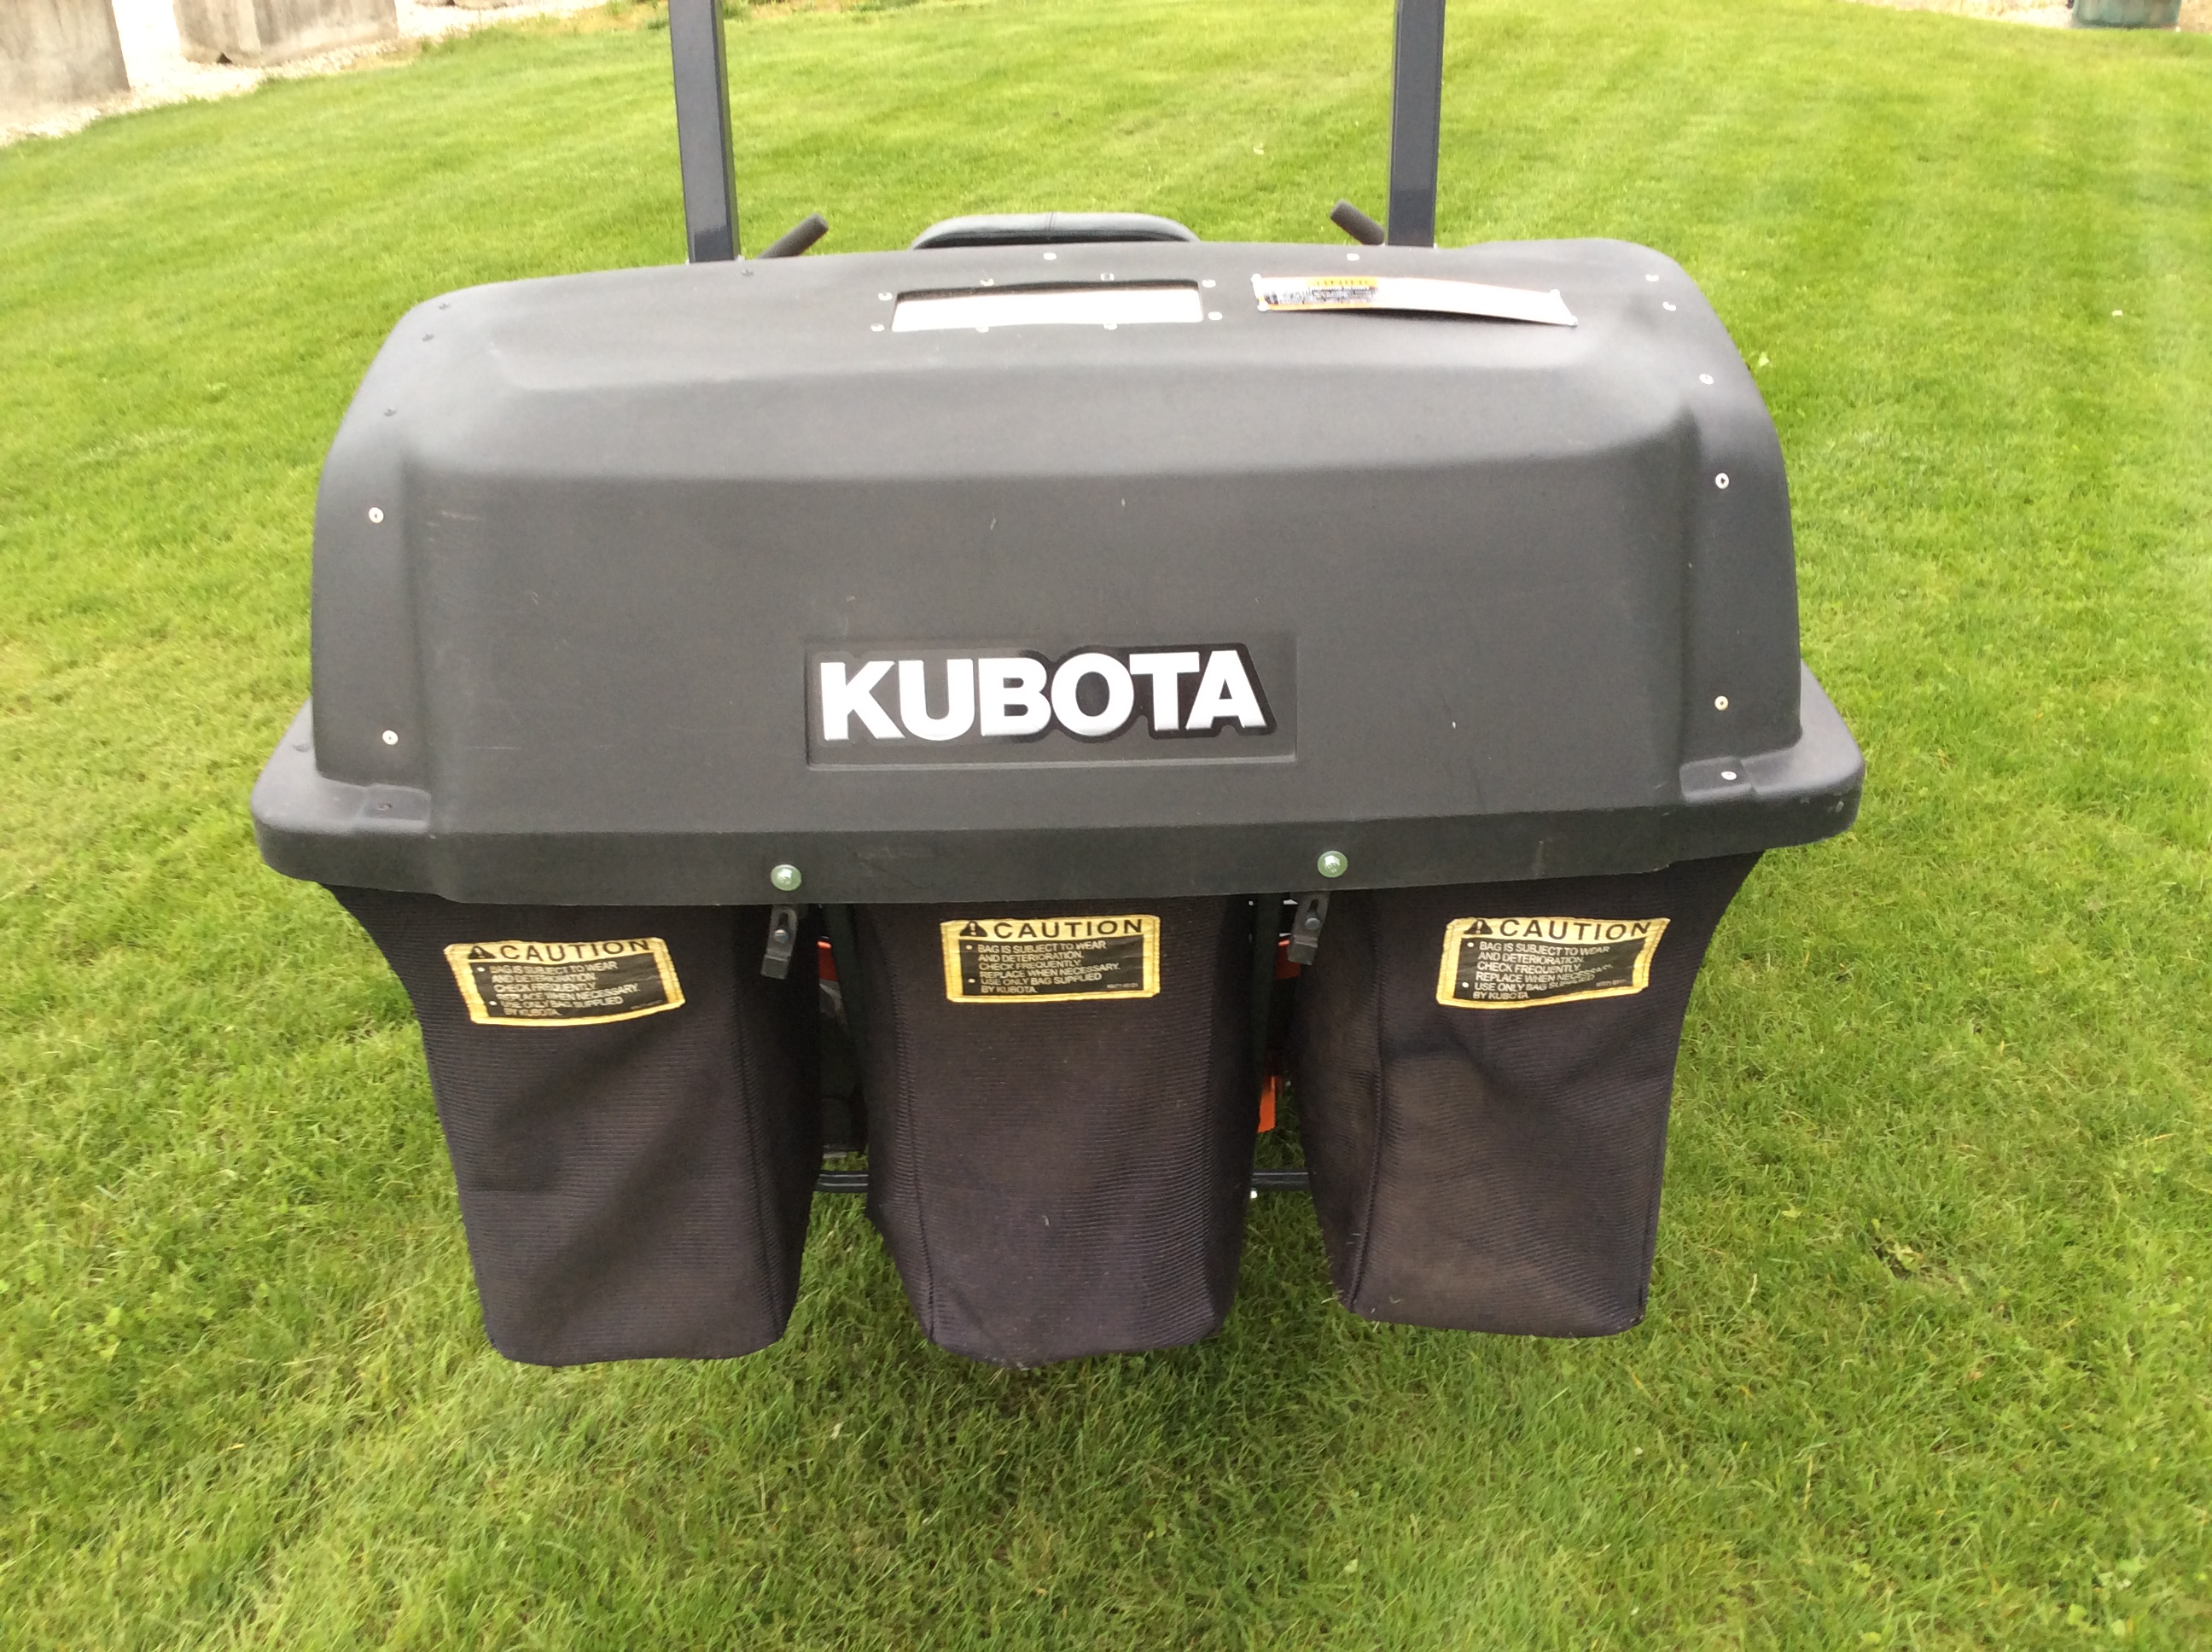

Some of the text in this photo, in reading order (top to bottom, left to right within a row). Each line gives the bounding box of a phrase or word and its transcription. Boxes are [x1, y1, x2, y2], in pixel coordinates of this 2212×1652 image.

[820, 649, 1266, 741] KUBOTA
[993, 919, 1142, 939] CAUTION
[1499, 919, 1651, 940] CAUTION
[500, 939, 649, 962] CAUTION
[977, 944, 1000, 953] BAG
[1000, 945, 1011, 953] IS
[1012, 943, 1057, 954] SUBJECT
[1076, 940, 1107, 950] WEAR
[1479, 941, 1610, 956] BAG IS SUBJECT TO WEAR
[978, 951, 1085, 963] AND DETERIORATION.
[1477, 951, 1501, 961] AND
[585, 961, 618, 972] WEAR
[978, 963, 1015, 971] CHECK
[1477, 961, 1513, 972] CHECK
[979, 970, 1026, 979] REPLACE
[1027, 969, 1058, 977] WHEN
[1030, 977, 1052, 986] BAG
[1053, 973, 1102, 985] SUPPLIED
[1476, 971, 1523, 983] REPLACE
[1524, 974, 1555, 983] WHEN
[981, 985, 995, 993] BY
[1475, 982, 1496, 991] USE
[1497, 983, 1525, 992] ONLY
[544, 992, 576, 1001] WHEN
[1473, 991, 1487, 999] BY
